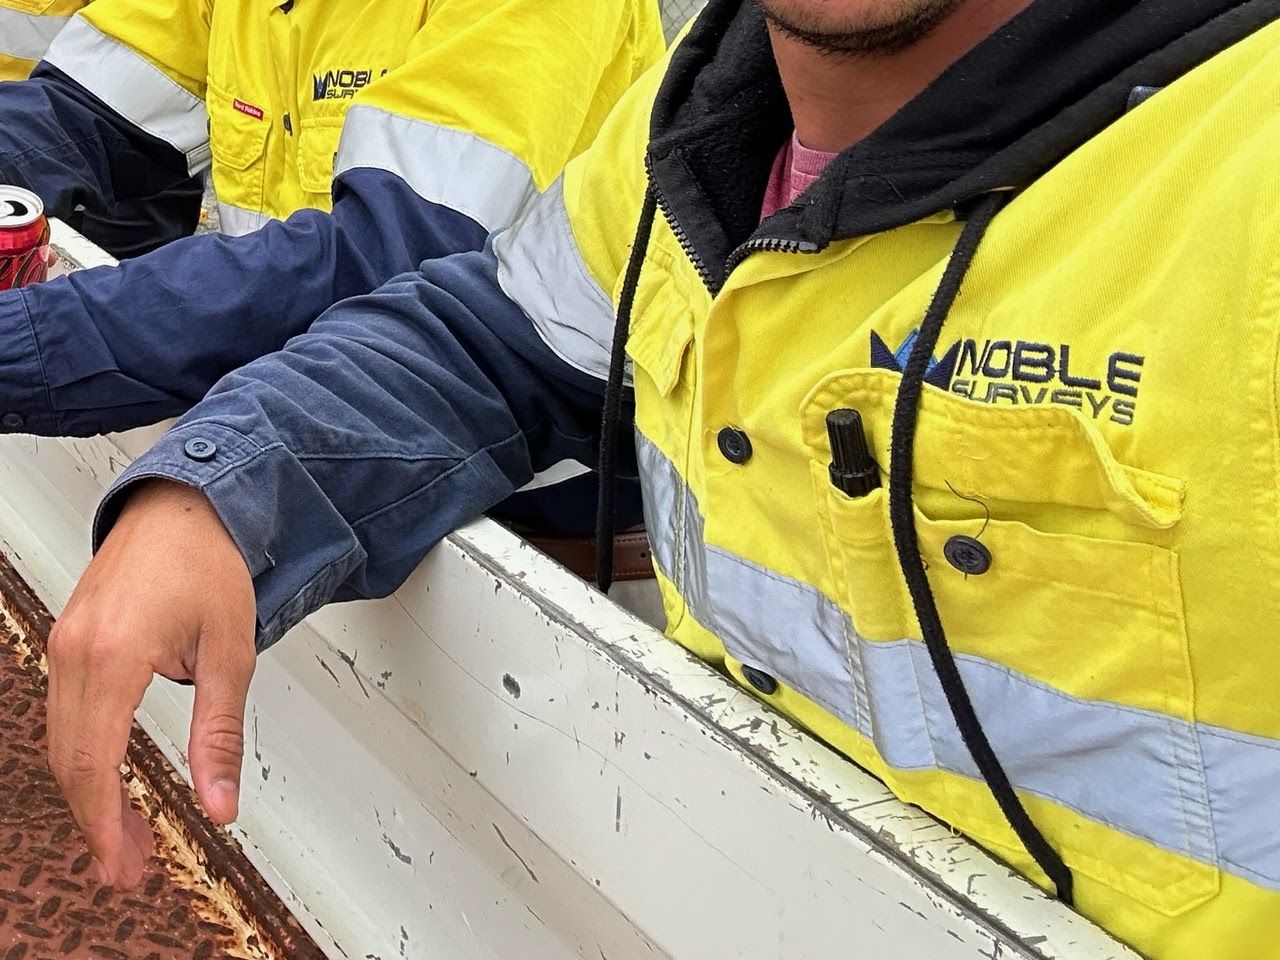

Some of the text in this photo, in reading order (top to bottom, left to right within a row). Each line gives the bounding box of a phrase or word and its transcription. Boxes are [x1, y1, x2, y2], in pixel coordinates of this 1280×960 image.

[326, 89, 359, 99] SUR
[327, 69, 388, 88] NOBL
[955, 339, 1145, 398] NOBLE
[951, 379, 1137, 426] SURVEYS
